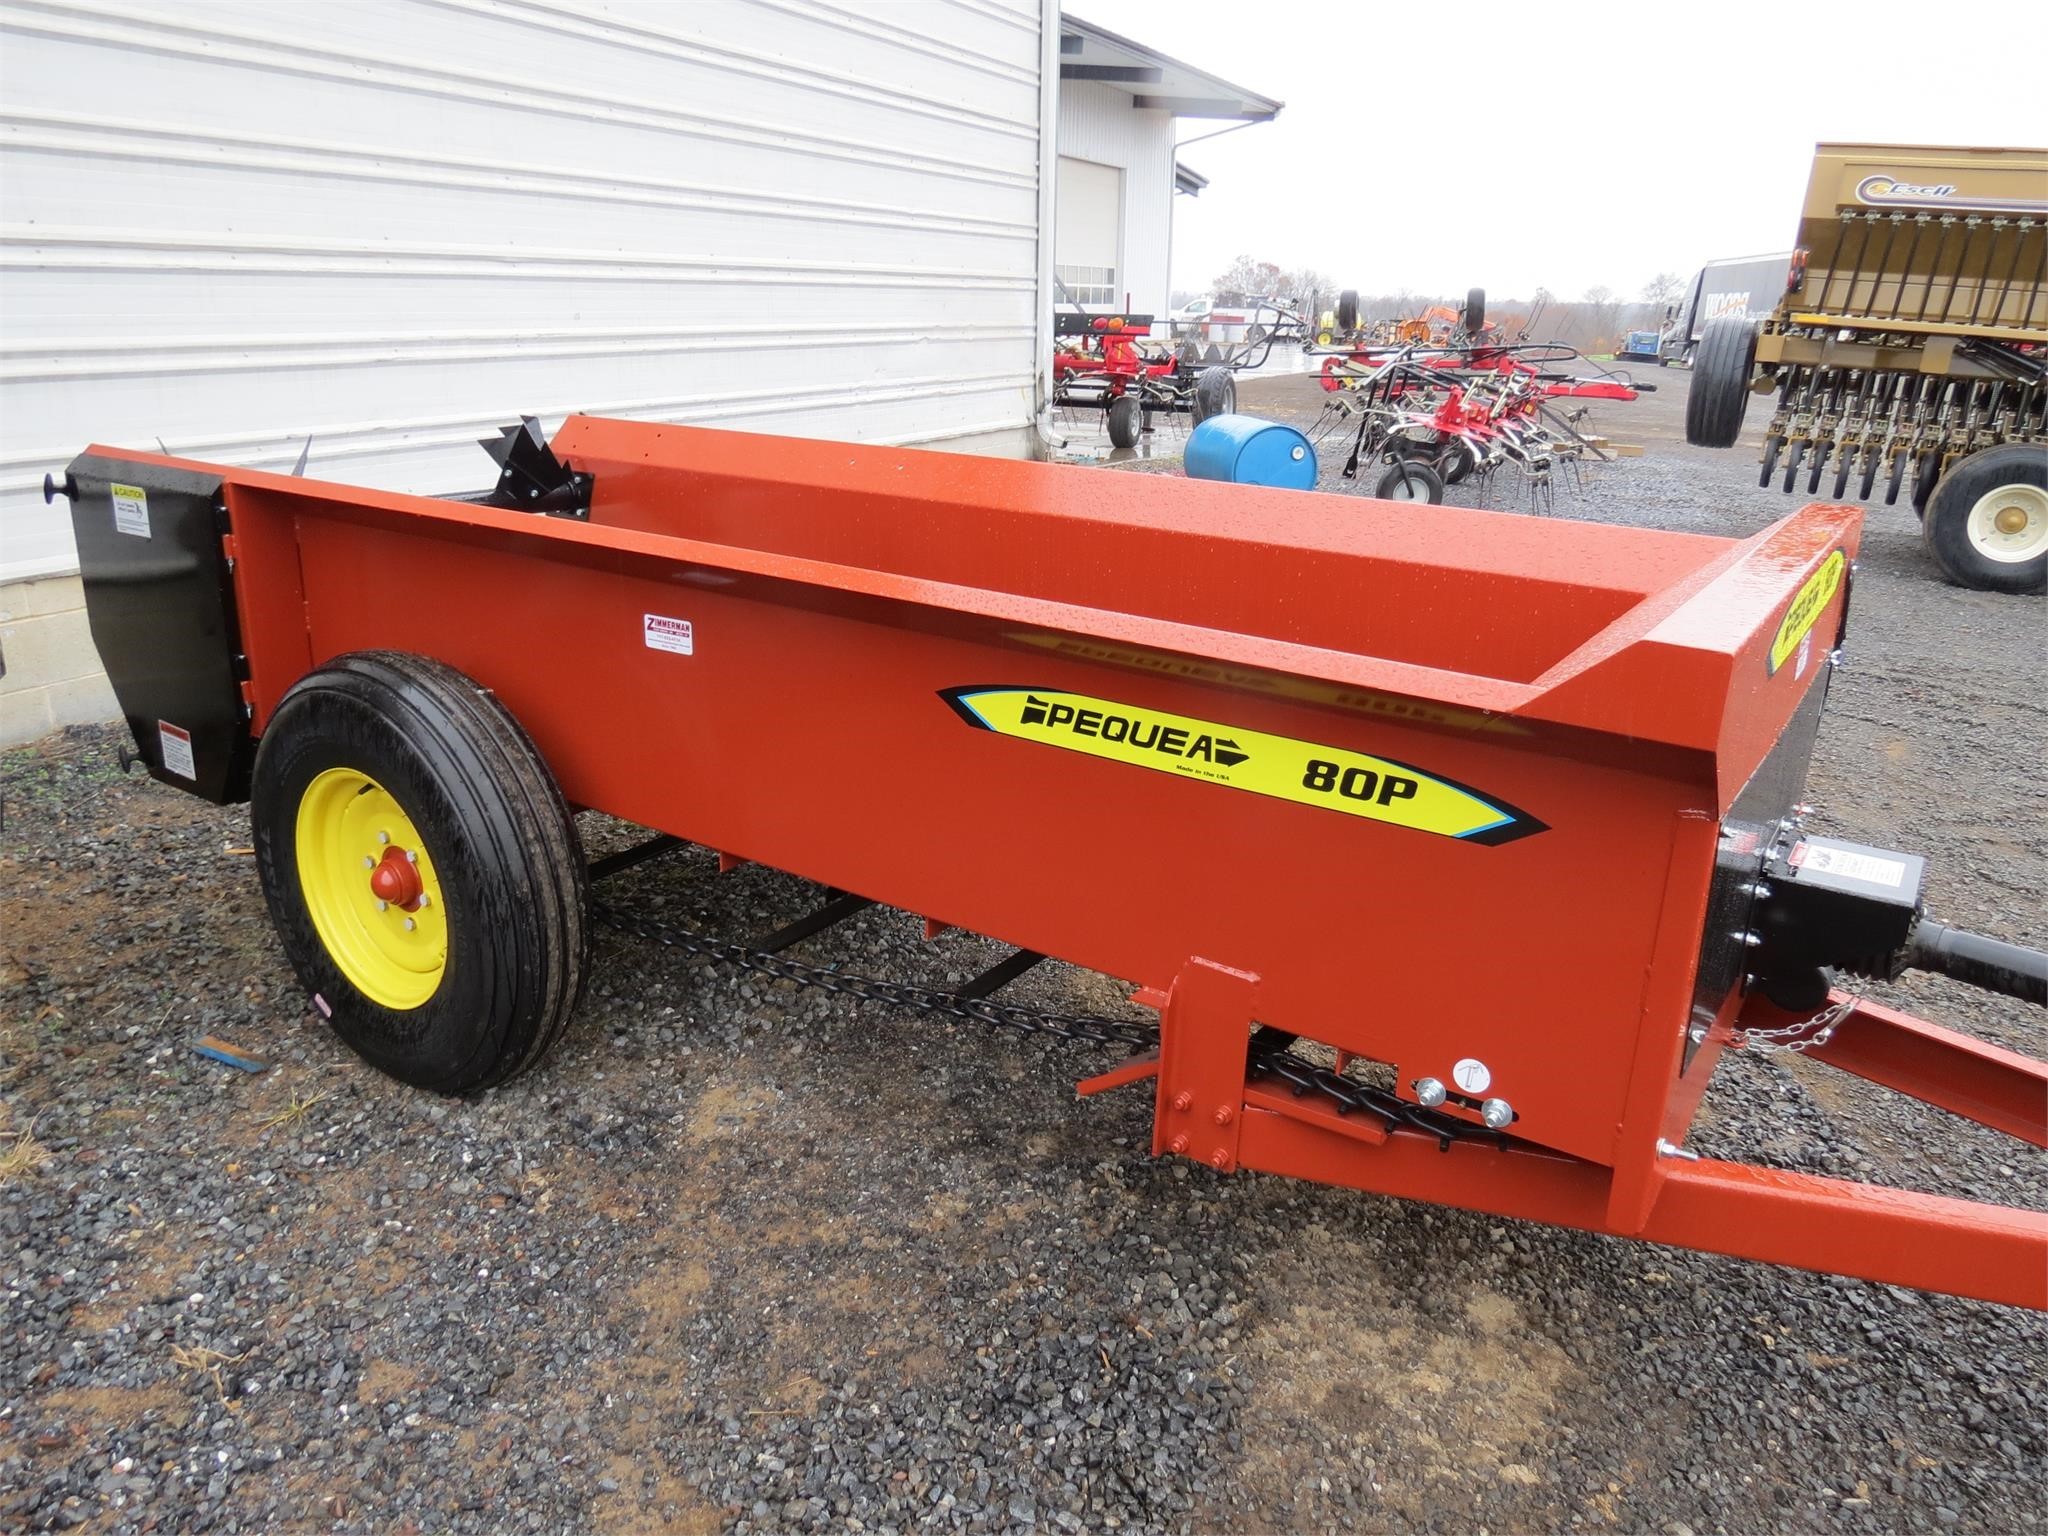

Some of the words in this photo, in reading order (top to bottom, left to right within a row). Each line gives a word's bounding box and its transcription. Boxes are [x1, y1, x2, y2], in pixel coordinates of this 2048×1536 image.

[647, 617, 690, 632] ZIMMERMAN
[1047, 703, 1213, 763] PEQUEA
[1176, 764, 1194, 773] Made
[1203, 770, 1215, 778] the
[1302, 759, 1419, 806] 80P
